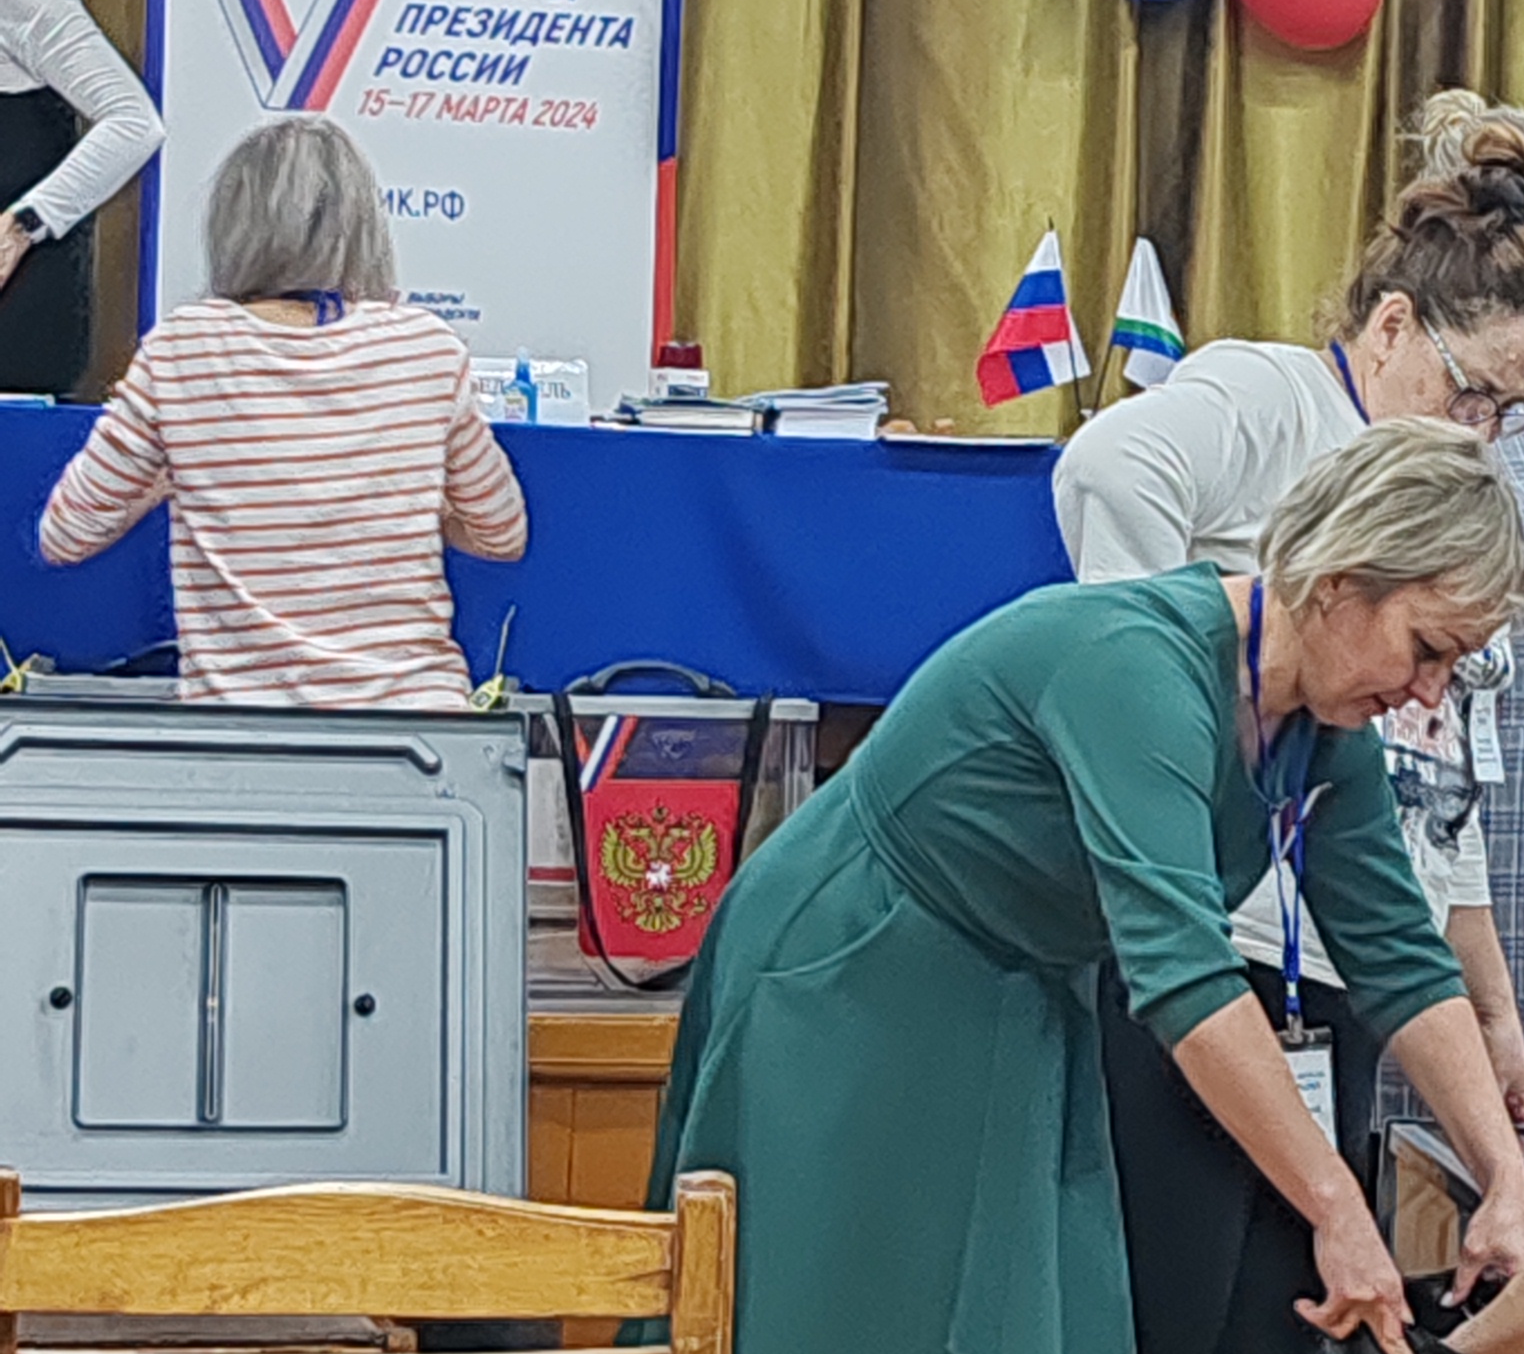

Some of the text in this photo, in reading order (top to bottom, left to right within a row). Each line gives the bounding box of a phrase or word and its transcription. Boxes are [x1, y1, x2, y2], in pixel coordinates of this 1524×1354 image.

[394, 3, 635, 49] ПРЕЗИДЕНТА
[373, 46, 531, 86] РОССИИ
[435, 92, 530, 126] МАРТА
[531, 99, 599, 130] 2024
[379, 188, 465, 221] ИК.РФ
